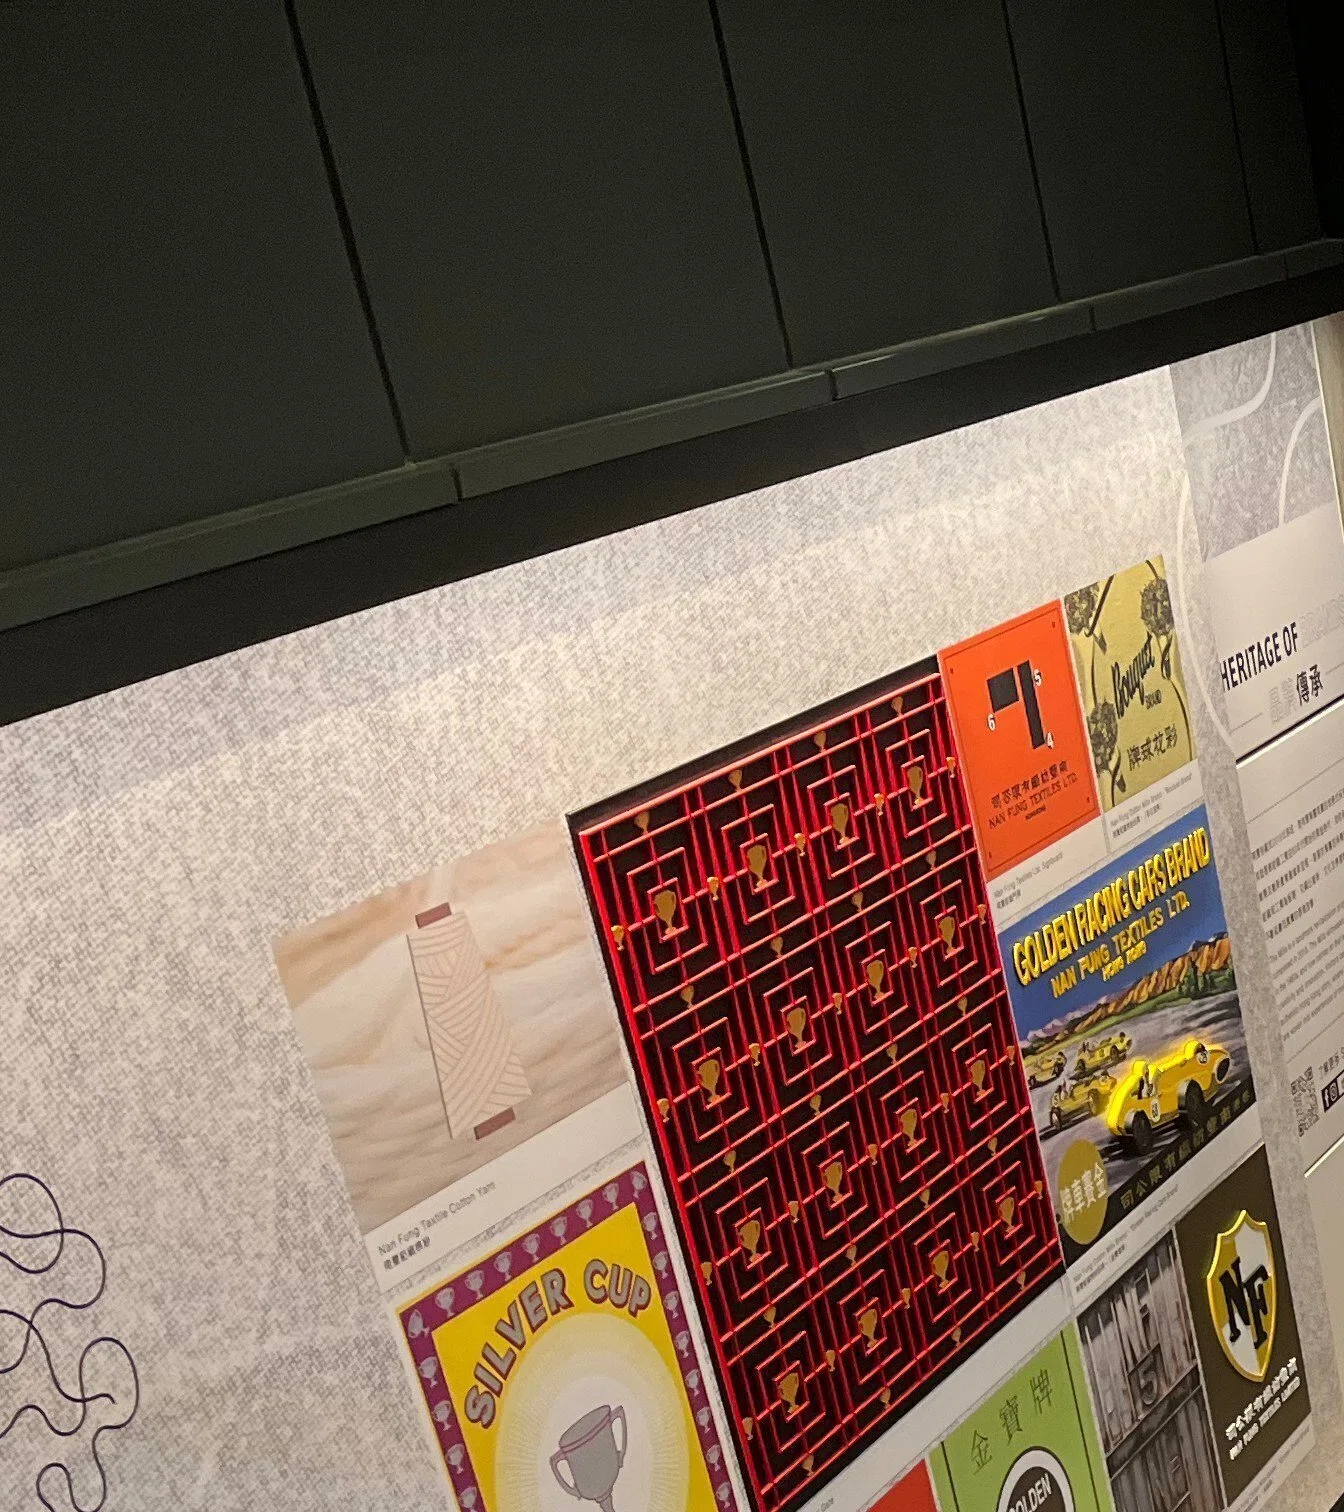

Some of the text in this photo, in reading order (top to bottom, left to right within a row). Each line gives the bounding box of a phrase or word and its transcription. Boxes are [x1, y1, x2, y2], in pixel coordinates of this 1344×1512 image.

[1220, 622, 1299, 692] HERITAGE OF
[1296, 663, 1324, 706] 傳承
[1013, 827, 1211, 985] GOLDEN RACING CARS BRAND
[1052, 970, 1077, 998] NAN
[1078, 944, 1111, 980] FUNG
[1112, 911, 1165, 957] TEXTILES
[463, 1258, 652, 1430] SILVER CUP
[1219, 1257, 1271, 1349] NF
[969, 1368, 1054, 1475] 金寶牌
